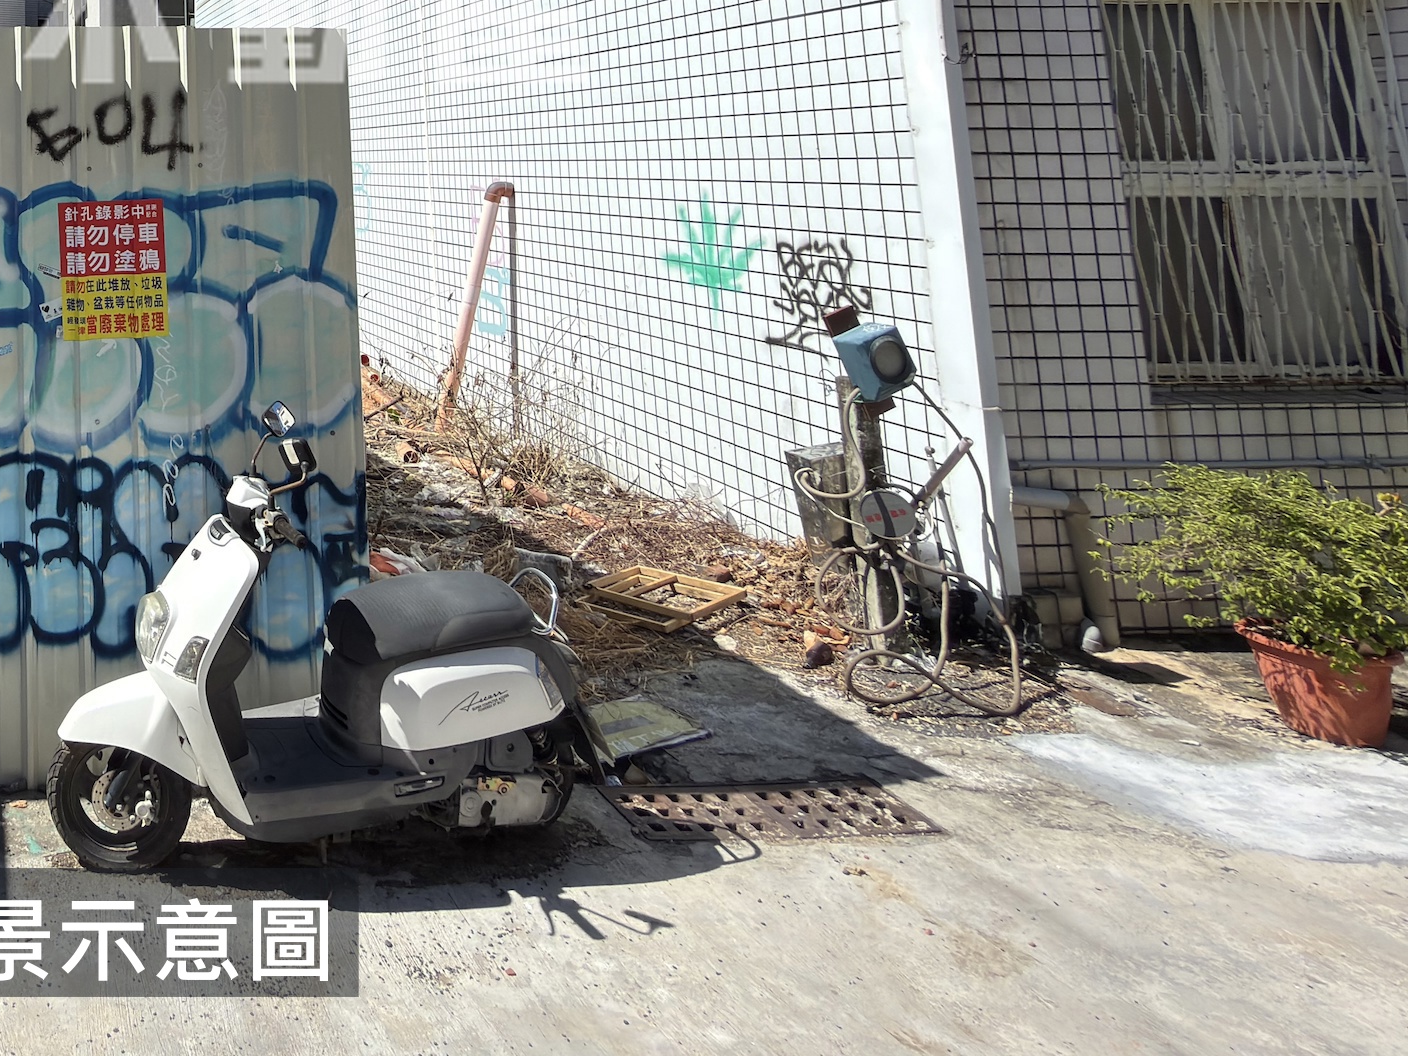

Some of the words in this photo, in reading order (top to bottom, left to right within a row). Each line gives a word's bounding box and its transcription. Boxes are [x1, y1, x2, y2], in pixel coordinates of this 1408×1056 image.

[64, 204, 145, 222] 針孔錄影中
[65, 222, 159, 248] 請勿停車
[65, 248, 160, 275] 請勿塗鴉
[65, 276, 162, 294] 請勿在此堆放、垃圾
[66, 294, 164, 312] 雜物、盆栽等任何物品
[87, 311, 165, 335] 當廢棄物處理
